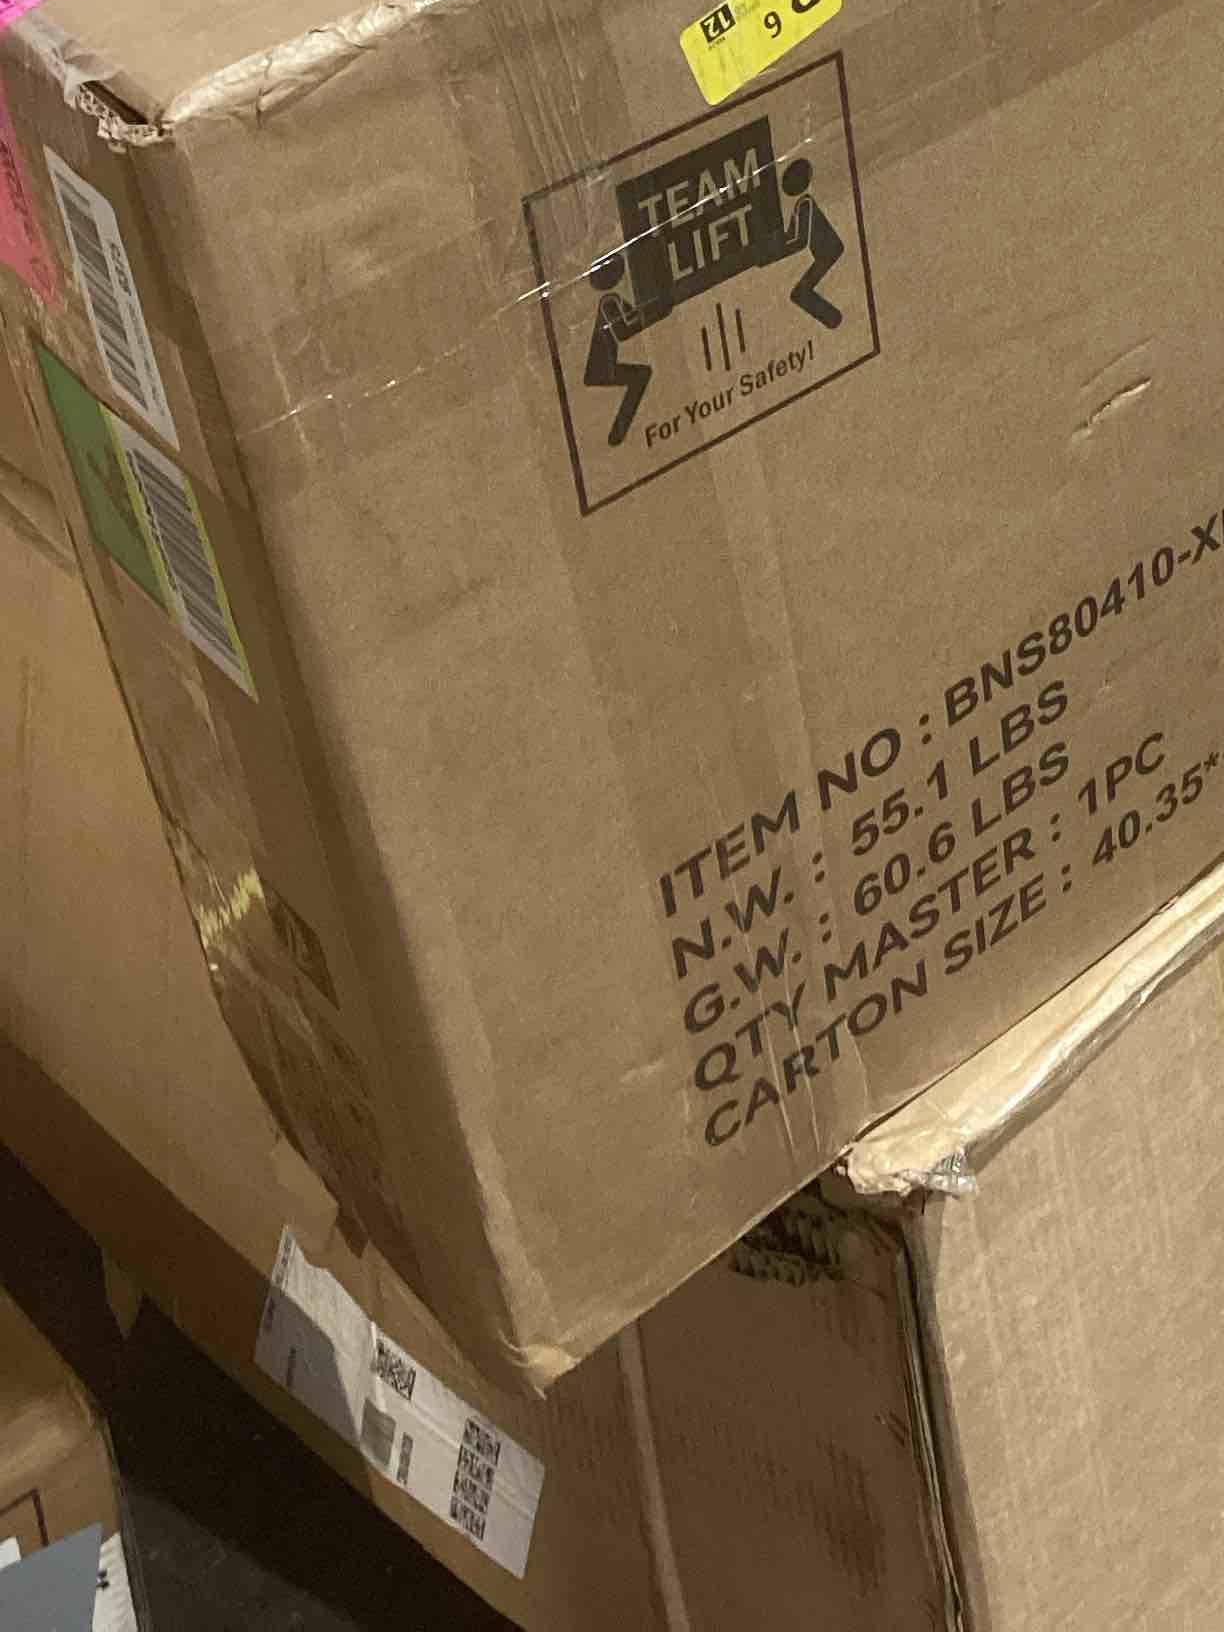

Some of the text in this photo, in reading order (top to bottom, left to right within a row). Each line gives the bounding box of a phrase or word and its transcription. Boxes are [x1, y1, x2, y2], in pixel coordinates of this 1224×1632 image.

[703, 7, 731, 38] 12
[638, 146, 762, 226] TEAM
[667, 204, 754, 279] LIFT
[644, 339, 816, 448] For Your Safety!
[657, 788, 802, 919] ITEM
[817, 727, 901, 811] NO
[671, 865, 795, 981] N.W.
[851, 760, 950, 857] 55.1
[969, 679, 1069, 777] LBS
[683, 927, 802, 1034] G.W.
[853, 821, 957, 916] 60.6
[971, 741, 1071, 838] LBS
[693, 980, 807, 1092] QTY
[822, 826, 1037, 1002] MASTER
[1077, 732, 1166, 816] 1PC
[703, 959, 928, 1148] CARTON
[943, 872, 1048, 976] SIZE
